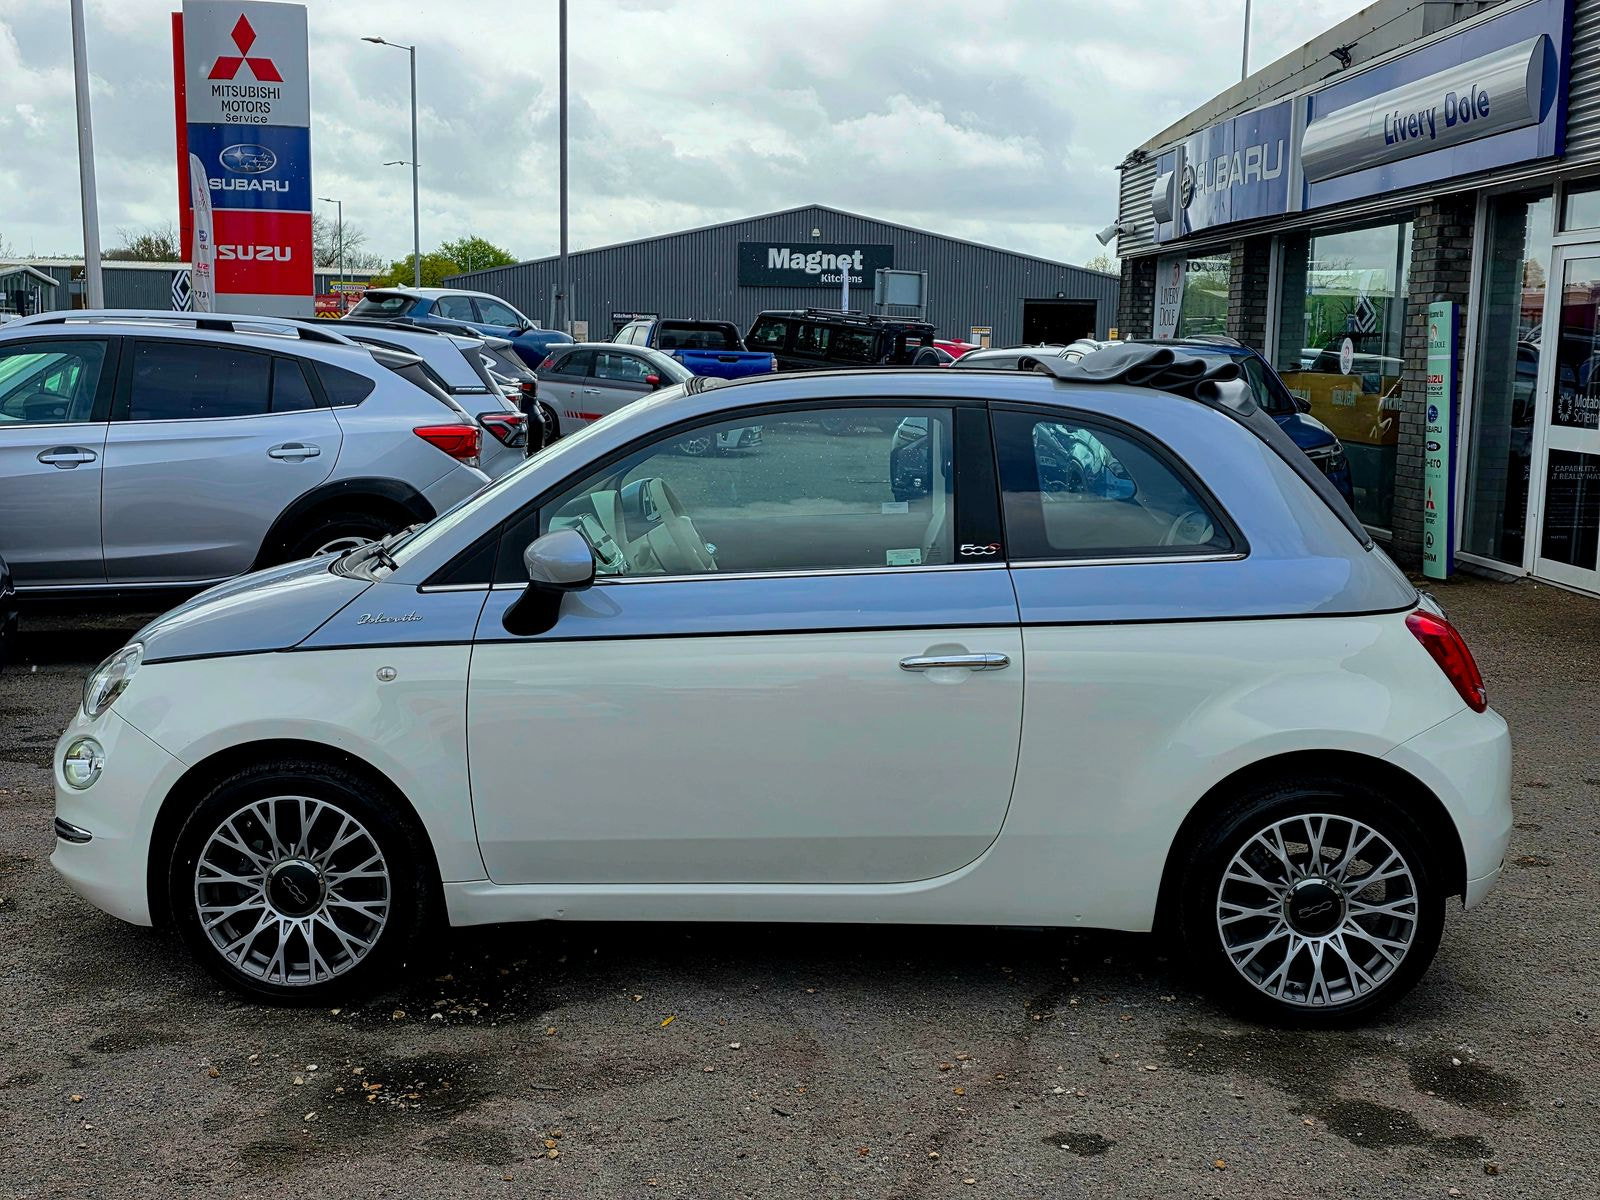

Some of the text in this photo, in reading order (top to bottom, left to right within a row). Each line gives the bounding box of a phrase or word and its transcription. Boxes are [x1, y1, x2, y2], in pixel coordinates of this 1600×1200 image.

[211, 84, 281, 100] MITSUBISHI
[221, 100, 271, 114] MOTORS
[1384, 83, 1490, 146] Livery Dole
[225, 113, 268, 124] Service
[1196, 139, 1284, 194] SUBARU
[208, 178, 289, 192] SUBARU
[768, 248, 863, 274] Magnet
[1573, 408, 1599, 424] Schem
[357, 609, 424, 626] Dolcevita
